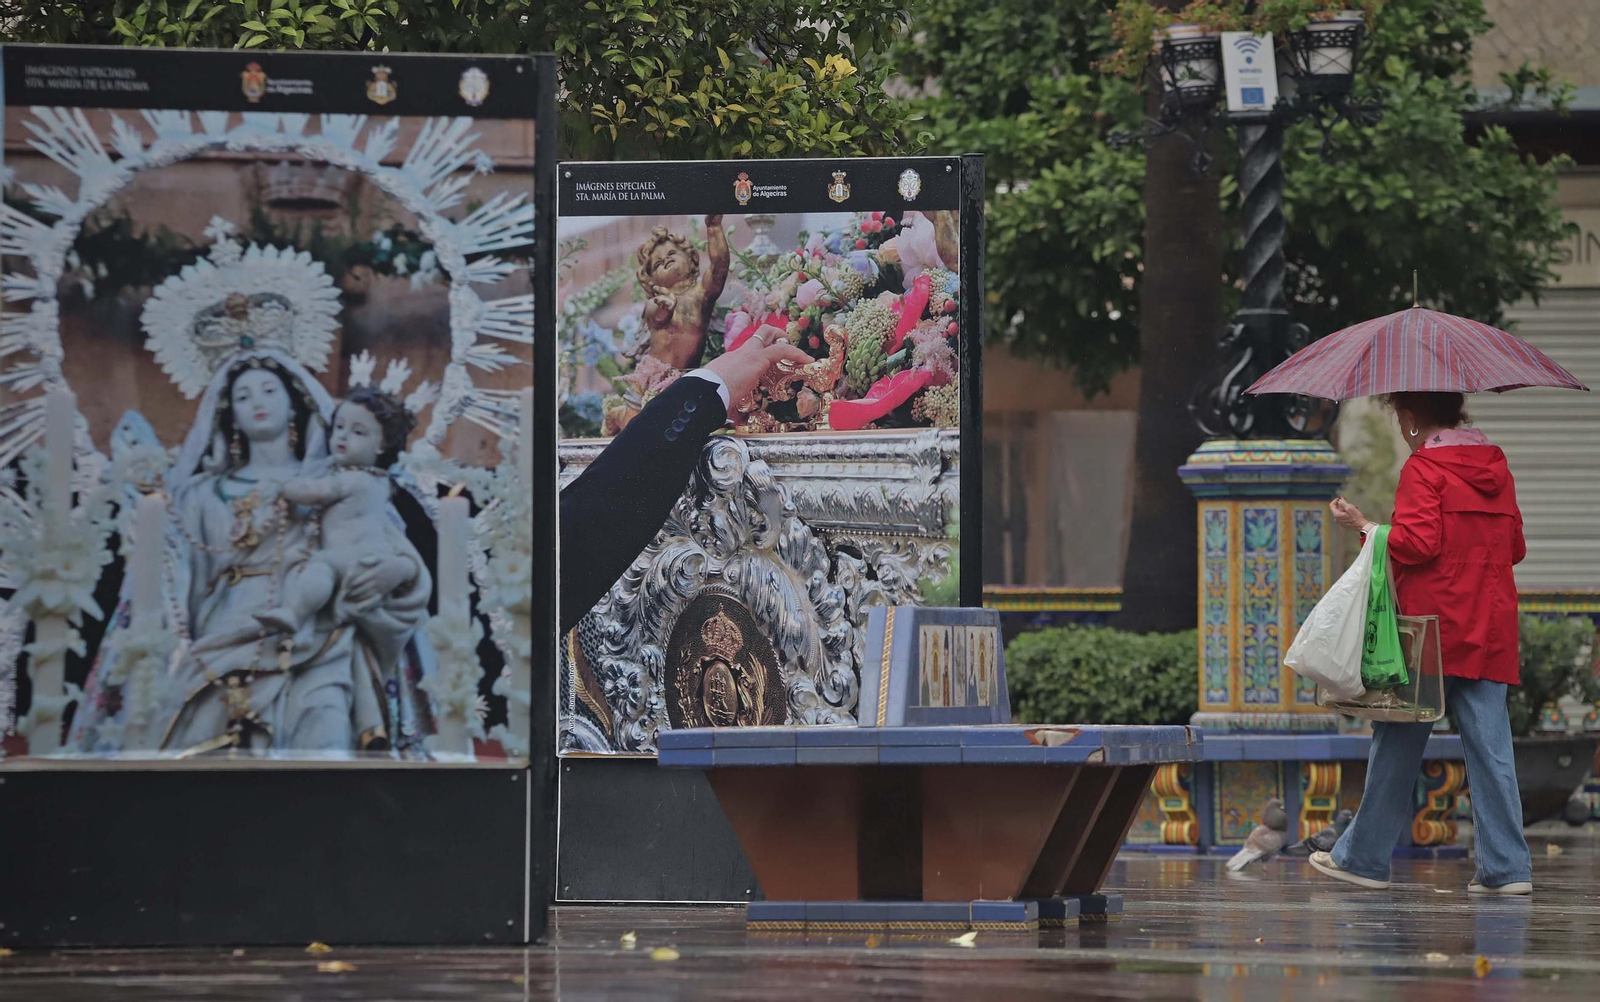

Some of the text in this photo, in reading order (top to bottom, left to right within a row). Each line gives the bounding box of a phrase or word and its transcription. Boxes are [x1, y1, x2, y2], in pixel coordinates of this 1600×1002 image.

[576, 181, 656, 191] IMÁGENES ESPECIALES
[576, 191, 666, 201] STA. MARÍA DE LA PALMA
